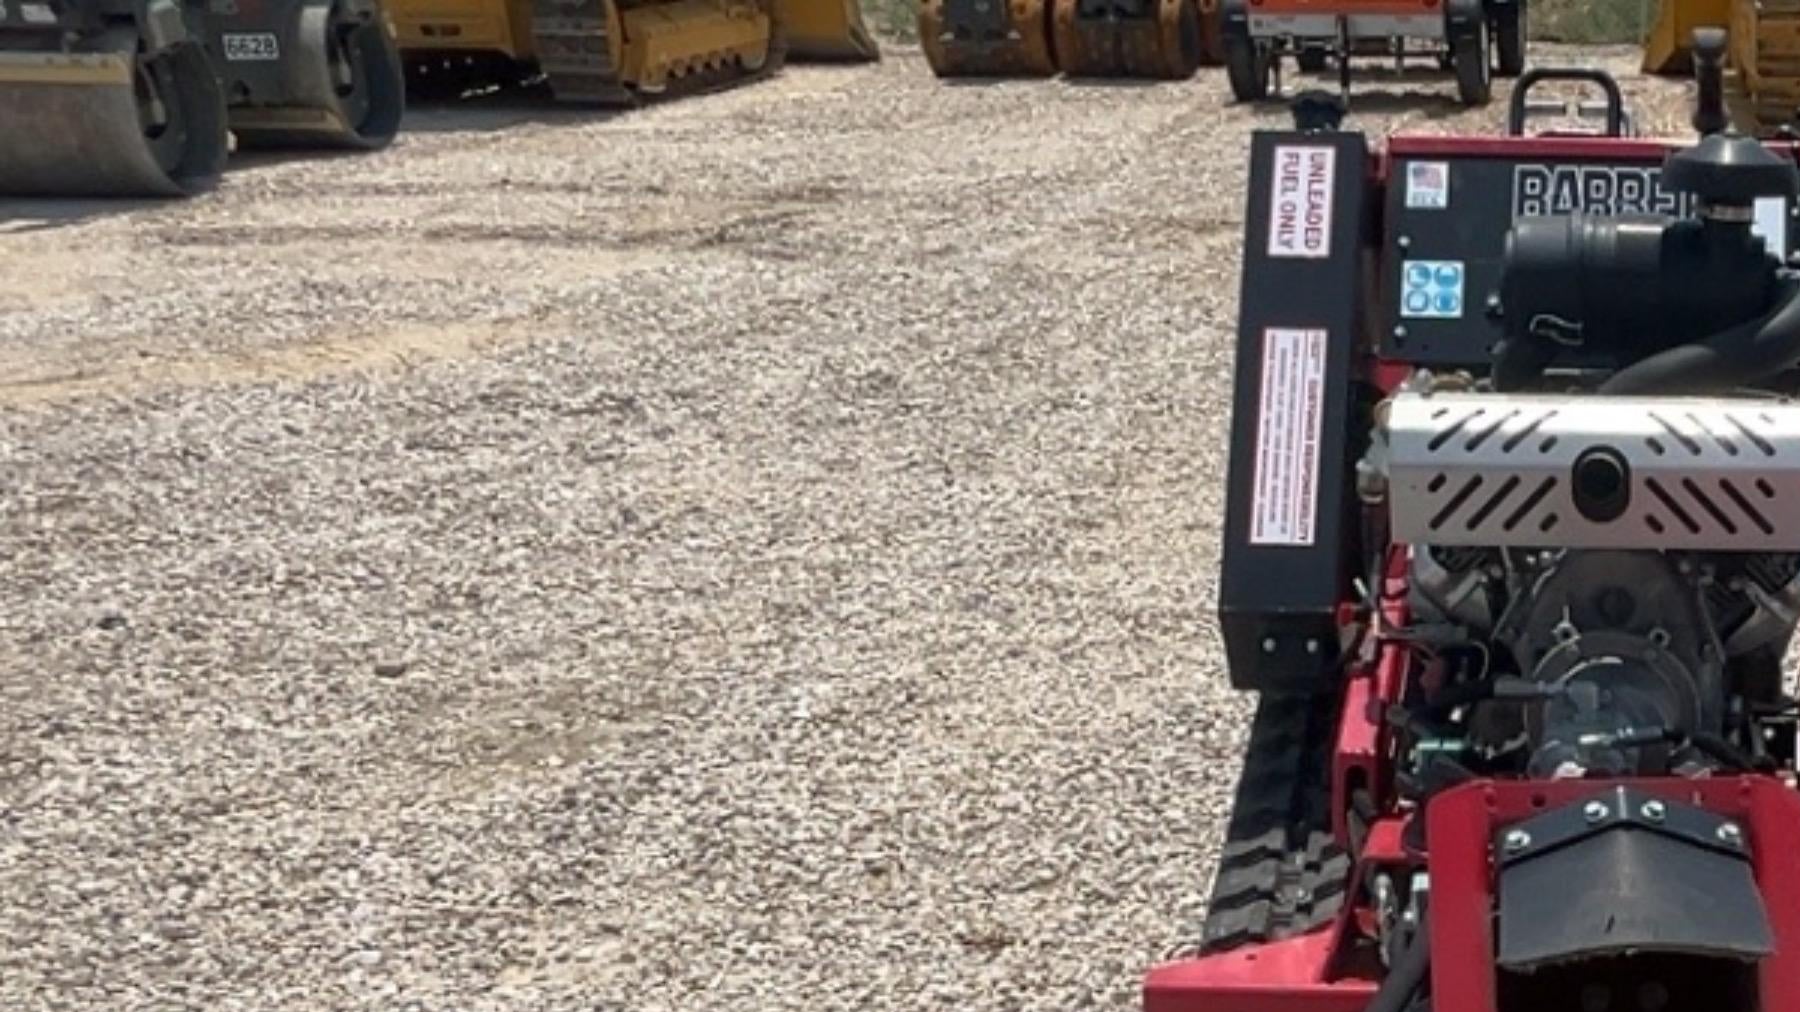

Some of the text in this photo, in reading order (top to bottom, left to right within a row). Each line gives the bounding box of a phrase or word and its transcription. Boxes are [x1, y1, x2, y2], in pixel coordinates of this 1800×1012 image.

[1278, 151, 1300, 250] FUEL ONLY
[1305, 151, 1327, 250] UNLEADED
